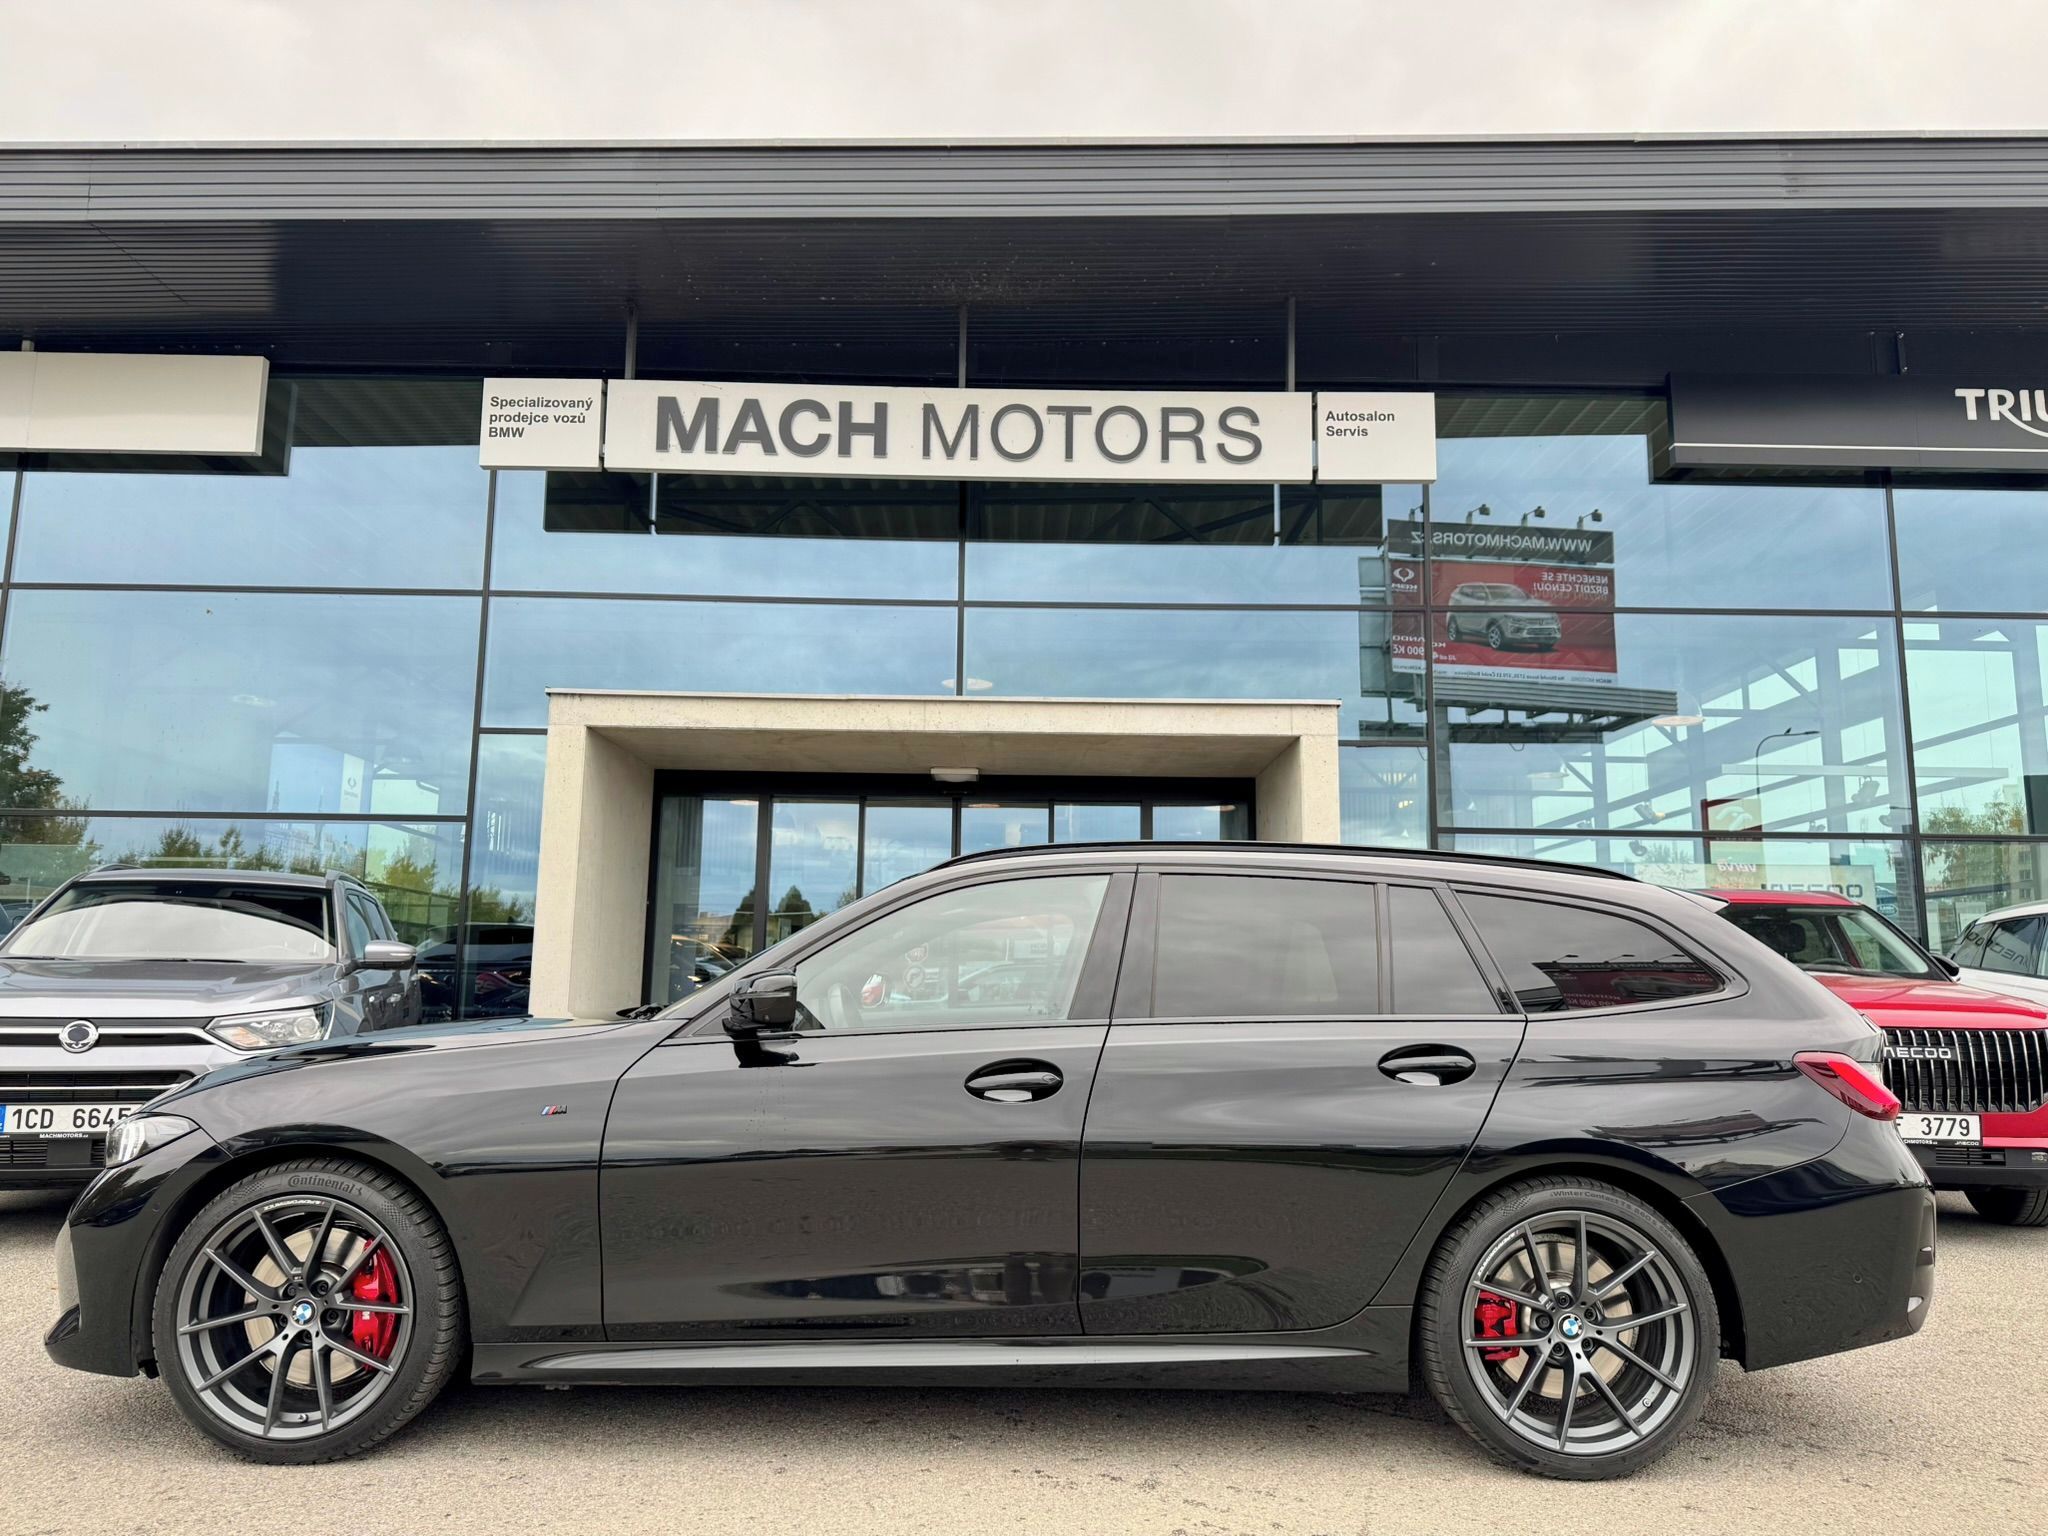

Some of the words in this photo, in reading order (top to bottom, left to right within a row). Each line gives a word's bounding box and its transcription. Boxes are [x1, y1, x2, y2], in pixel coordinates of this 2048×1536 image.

[490, 396, 593, 411] Specializovaný
[489, 412, 549, 425] prodejce
[553, 412, 586, 423] vozů
[1325, 411, 1395, 422] Autosalon
[488, 427, 525, 438] BMW
[656, 396, 888, 458] MACH
[922, 403, 1263, 464] MOTORS
[1326, 426, 1369, 437] Servis
[1884, 1047, 1951, 1058] AECOO
[12, 1108, 54, 1129] 1CD
[1921, 1117, 1970, 1136] 3779
[288, 1175, 356, 1194] Continental
